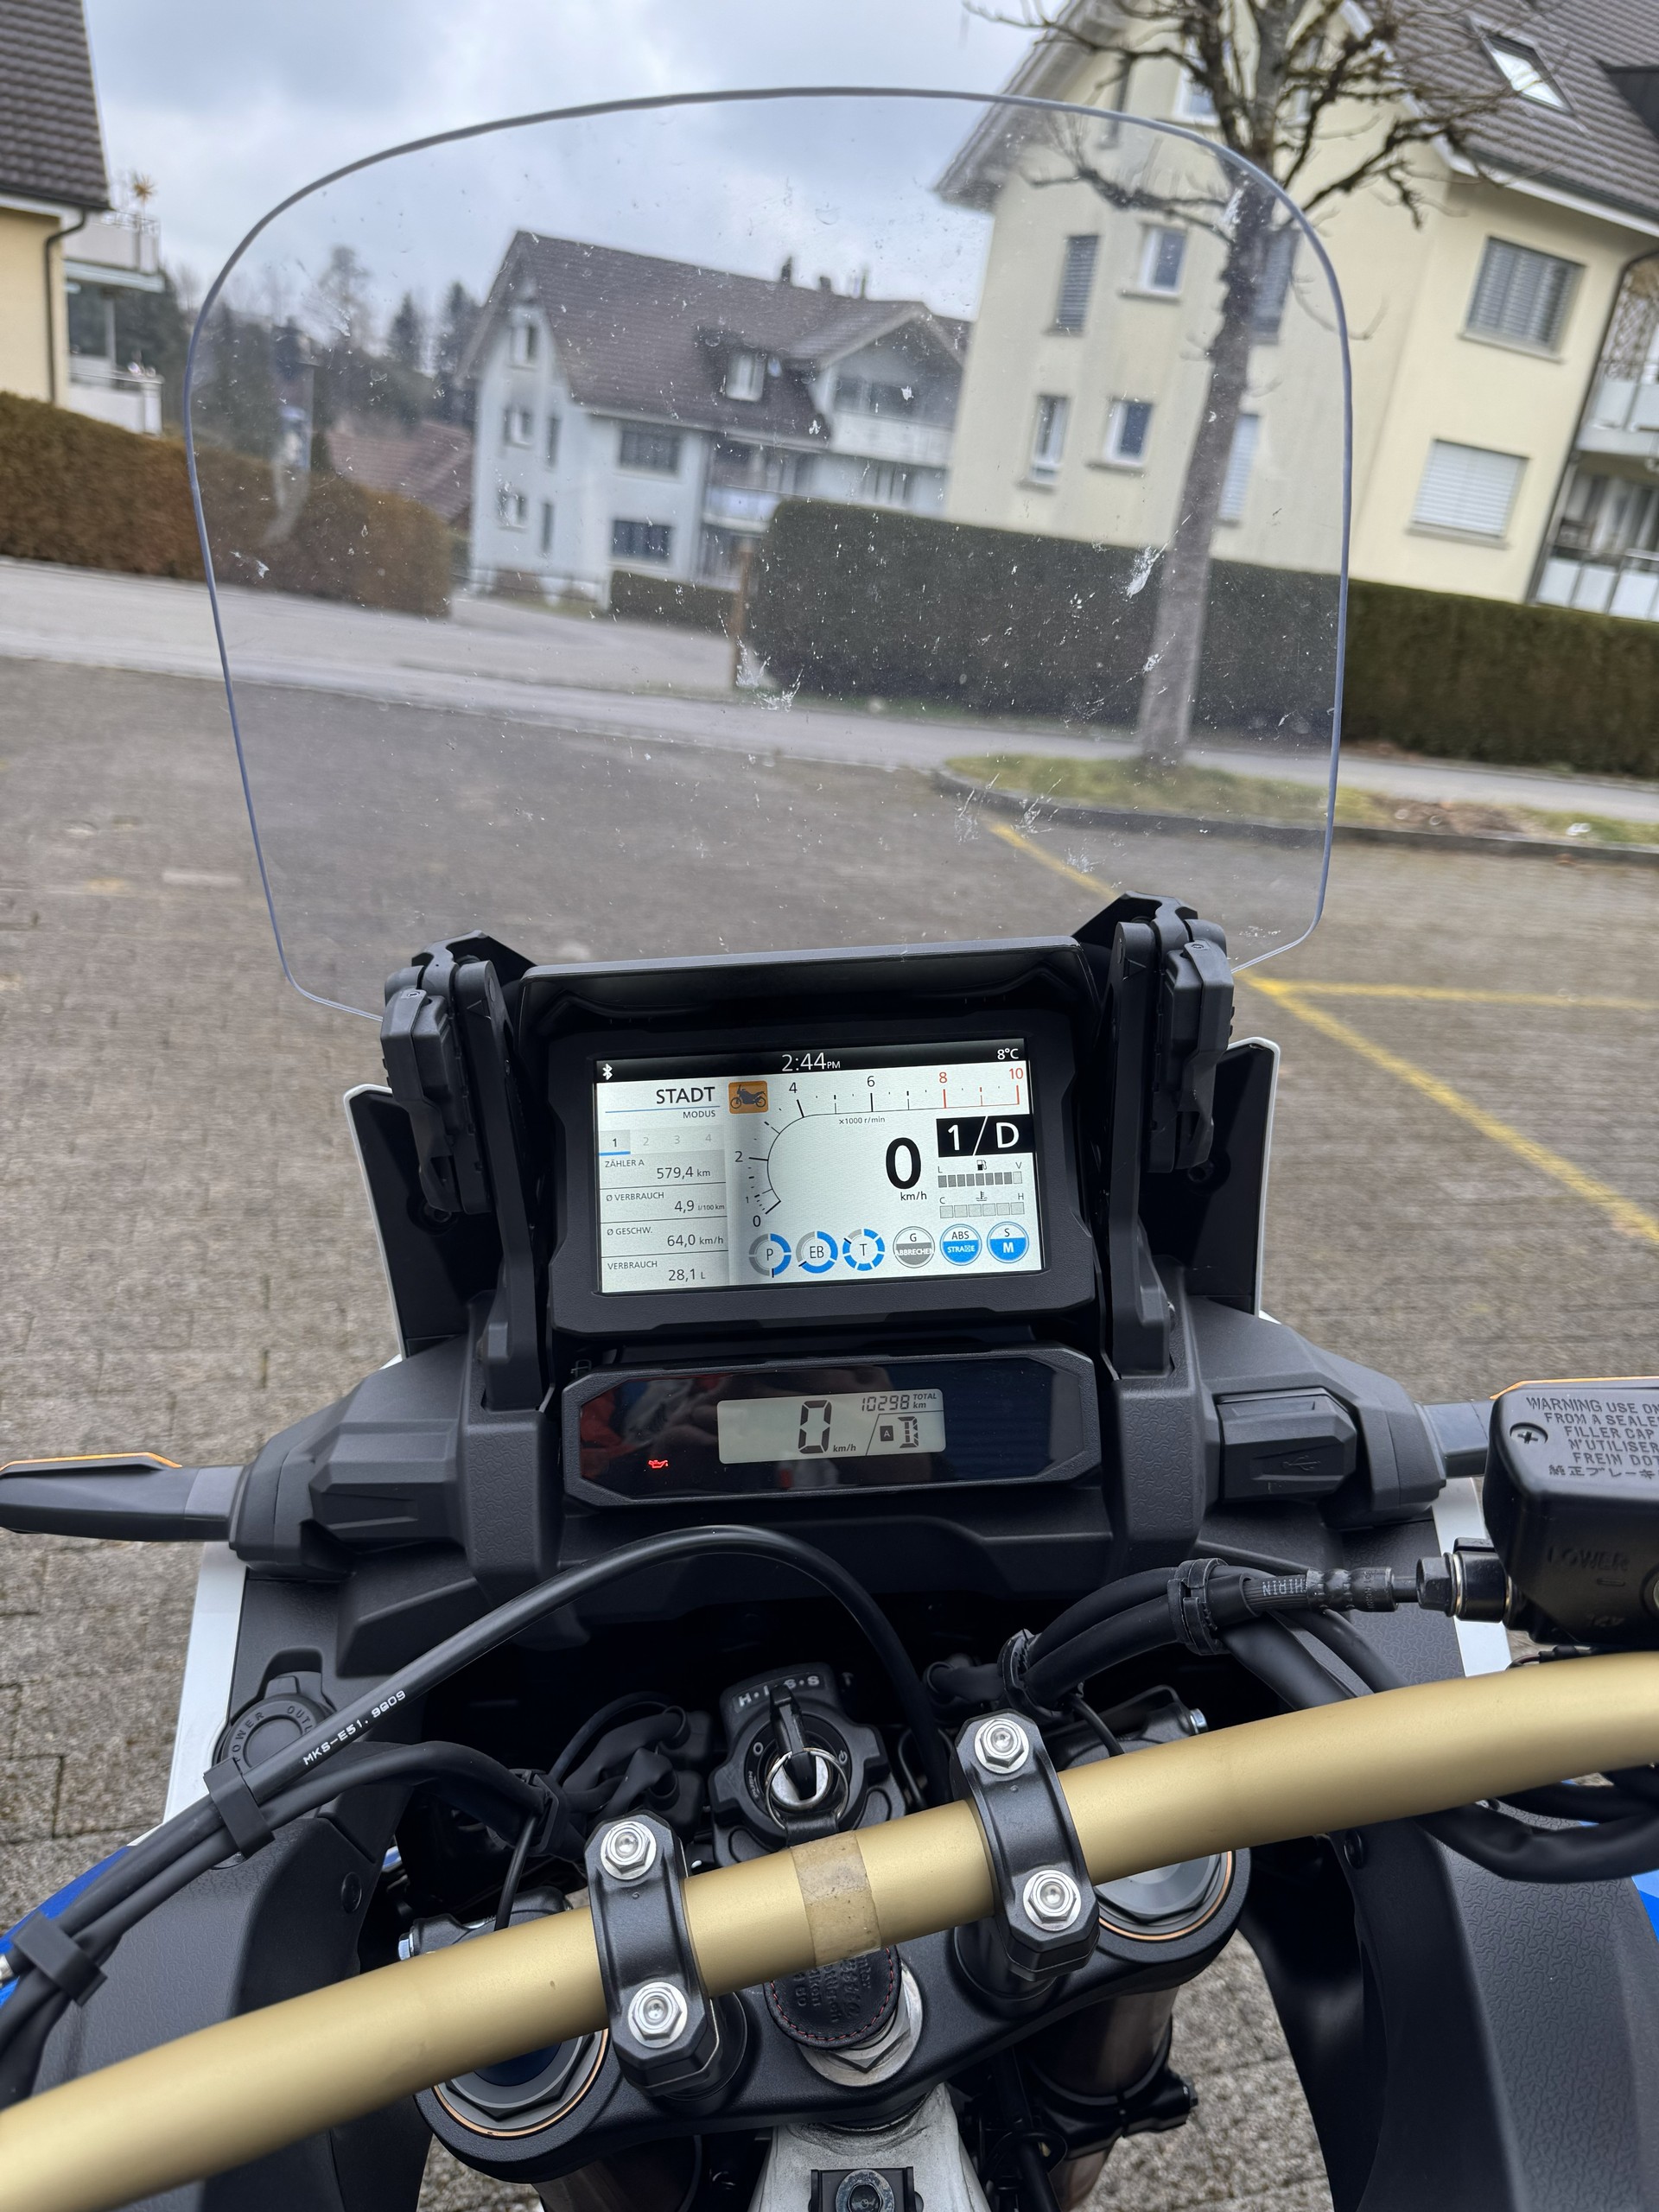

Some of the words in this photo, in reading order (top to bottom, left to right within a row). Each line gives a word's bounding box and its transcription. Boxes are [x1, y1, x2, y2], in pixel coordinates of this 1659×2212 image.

[996, 1048, 1020, 1060] 8°C
[938, 1071, 948, 1084] 8
[1009, 1067, 1024, 1079] 10
[867, 1075, 875, 1087] 6
[788, 1082, 798, 1094] 4
[656, 1086, 715, 1104] STADT
[683, 1109, 716, 1119] MODUS
[612, 1138, 618, 1147] 1
[642, 1136, 650, 1146] 2
[674, 1135, 681, 1145] 3
[705, 1134, 712, 1143] 4
[604, 1159, 637, 1168] ZÄHLER
[734, 1151, 743, 1163] 2
[885, 1137, 922, 1190] 0
[657, 1166, 694, 1179] 579,4
[614, 1192, 664, 1202] VERBRAUCH
[899, 1191, 927, 1201] km/h
[674, 1200, 695, 1213] 4,9
[753, 1215, 761, 1228] 0
[615, 1227, 653, 1236] GESCHW.
[909, 1233, 917, 1243] G
[951, 1230, 969, 1240] ABS
[1004, 1228, 1010, 1237] S
[667, 1234, 696, 1248] 64,0
[699, 1236, 724, 1245] km/h
[1002, 1242, 1014, 1253] M
[766, 1248, 774, 1261] P
[809, 1245, 824, 1259] EB
[859, 1243, 868, 1256] T
[607, 1261, 658, 1270] VERBRAUCH
[668, 1268, 696, 1281] 28,1
[861, 1395, 910, 1411] 10298
[1526, 1396, 1603, 1412] WARNING
[1606, 1402, 1638, 1414] USE
[1544, 1412, 1587, 1425] FROM
[1592, 1414, 1601, 1425] A
[1605, 1414, 1659, 1427] SEALE
[798, 1400, 832, 1454] 0
[1563, 1426, 1621, 1439] FILLER
[1624, 1427, 1654, 1440] CAP
[832, 1443, 856, 1453] km/h
[1572, 1452, 1623, 1465] FREIN
